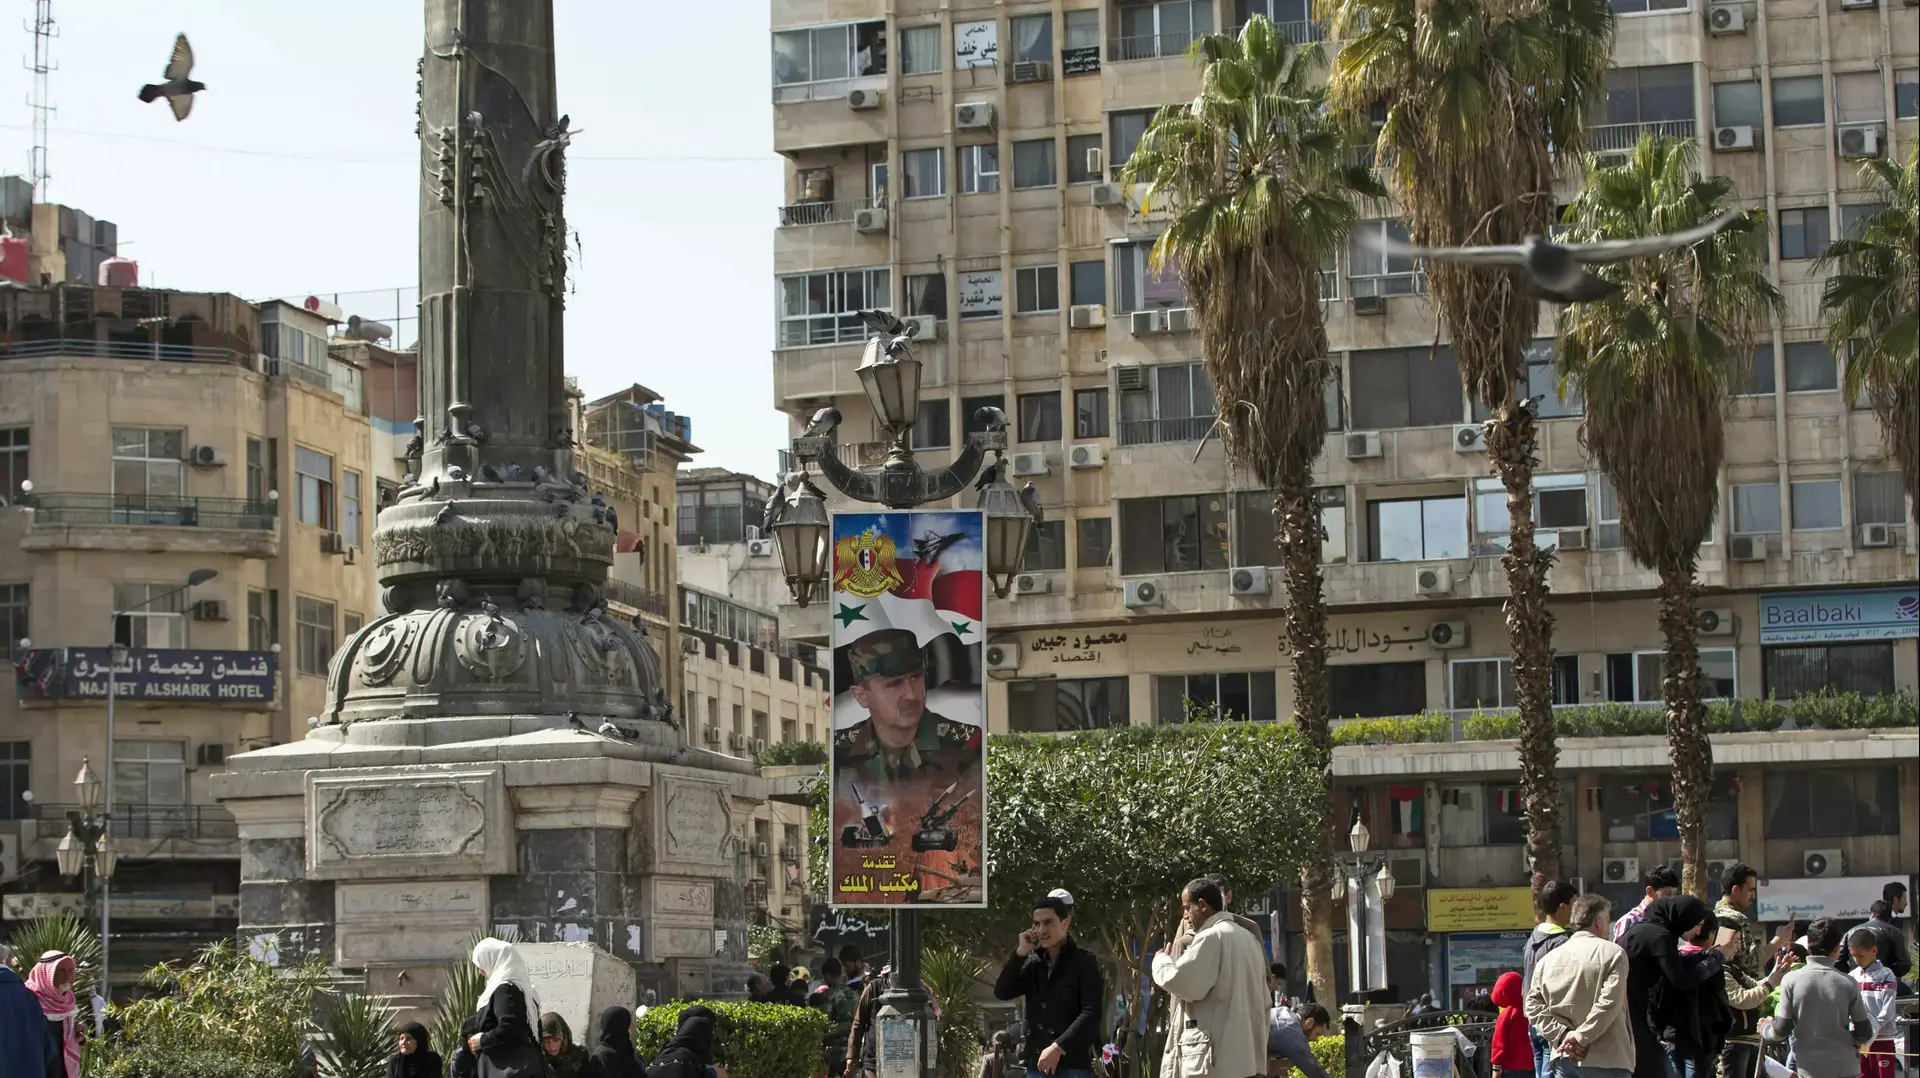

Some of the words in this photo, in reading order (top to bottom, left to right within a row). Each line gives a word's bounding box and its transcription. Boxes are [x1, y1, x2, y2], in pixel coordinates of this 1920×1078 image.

[965, 24, 988, 37] المحامي
[956, 40, 977, 56] خلف
[980, 41, 997, 58] علي
[967, 275, 994, 287] المحامية
[986, 295, 1002, 306] سمر
[1767, 602, 1862, 625] Baalbaki
[1073, 632, 1127, 649] محمود
[148, 653, 205, 681] نجمة
[211, 655, 268, 680] فندق
[144, 682, 211, 697] ALSHARK
[218, 684, 264, 698] HOTEL
[861, 855, 896, 869] تقدمة
[839, 874, 874, 892] الملك
[879, 873, 918, 897] مكتب
[1475, 988, 1488, 996] LG
